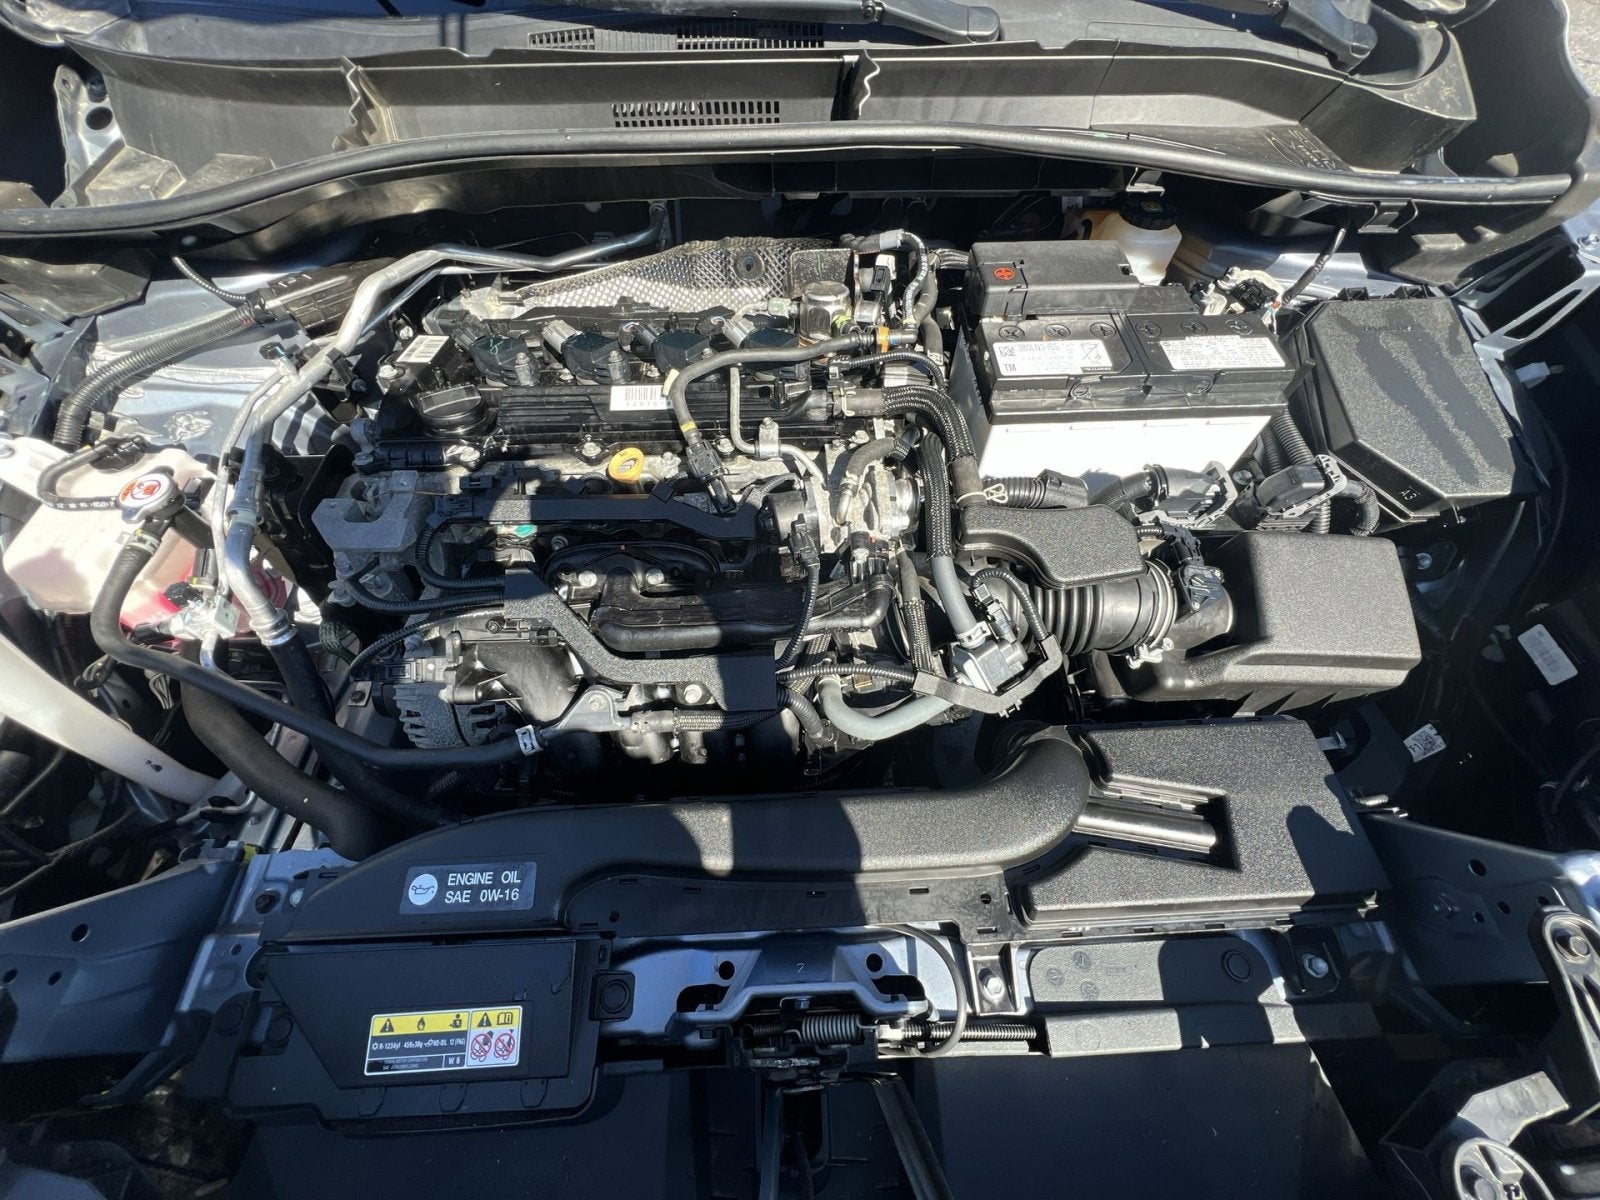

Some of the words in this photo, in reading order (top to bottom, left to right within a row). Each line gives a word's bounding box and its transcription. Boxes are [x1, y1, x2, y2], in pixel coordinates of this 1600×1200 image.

[1003, 363, 1017, 372] TM
[1398, 489, 1418, 501] A3
[447, 872, 493, 886] ENGINE
[501, 870, 521, 884] OIL
[444, 889, 471, 904] SAE
[479, 888, 520, 902] 0W-16
